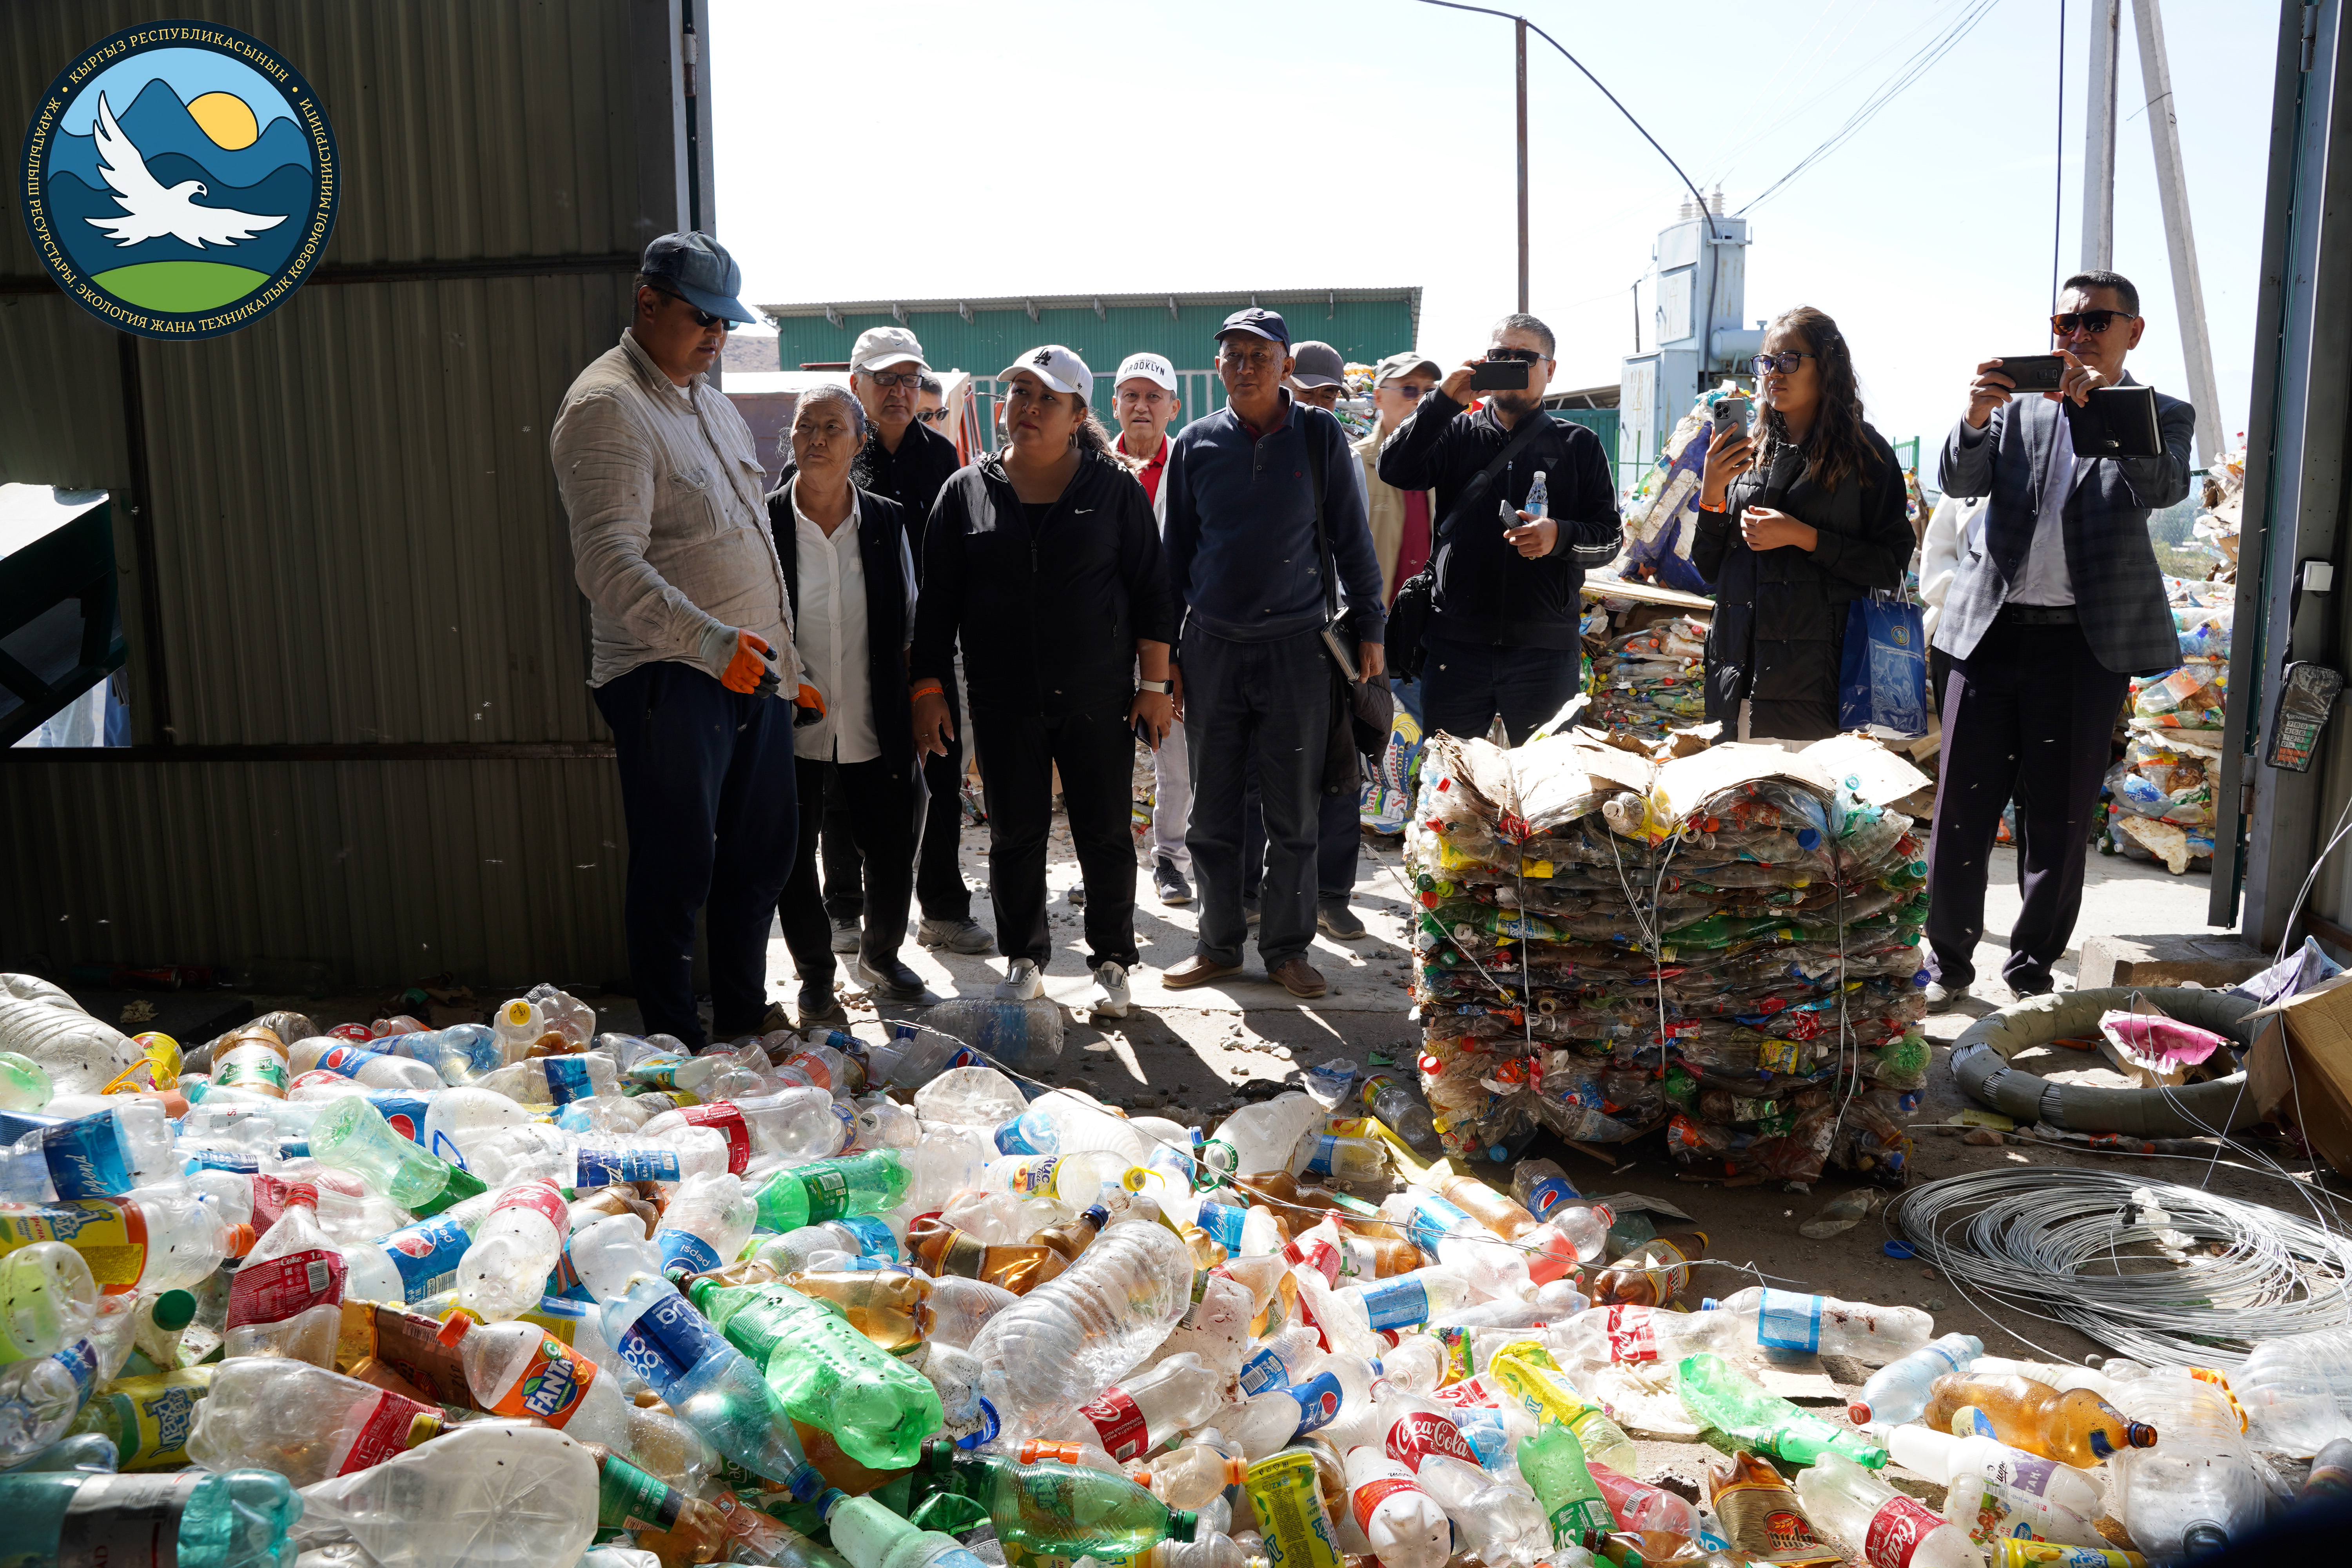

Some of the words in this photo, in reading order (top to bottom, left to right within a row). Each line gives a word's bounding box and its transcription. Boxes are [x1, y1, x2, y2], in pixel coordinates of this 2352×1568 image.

[1033, 347, 1052, 366] LA
[1124, 361, 1165, 376] BROOKLYN
[1397, 745, 1405, 779] GOLD
[1917, 973, 1930, 983] asu
[65, 1154, 111, 1199] Legend
[680, 1244, 711, 1266] pepsi
[528, 1358, 573, 1416] FANTA
[1113, 1414, 1142, 1434] ПЕРЕРАБОТАЙ
[1396, 1417, 1469, 1456] Coca-Cola
